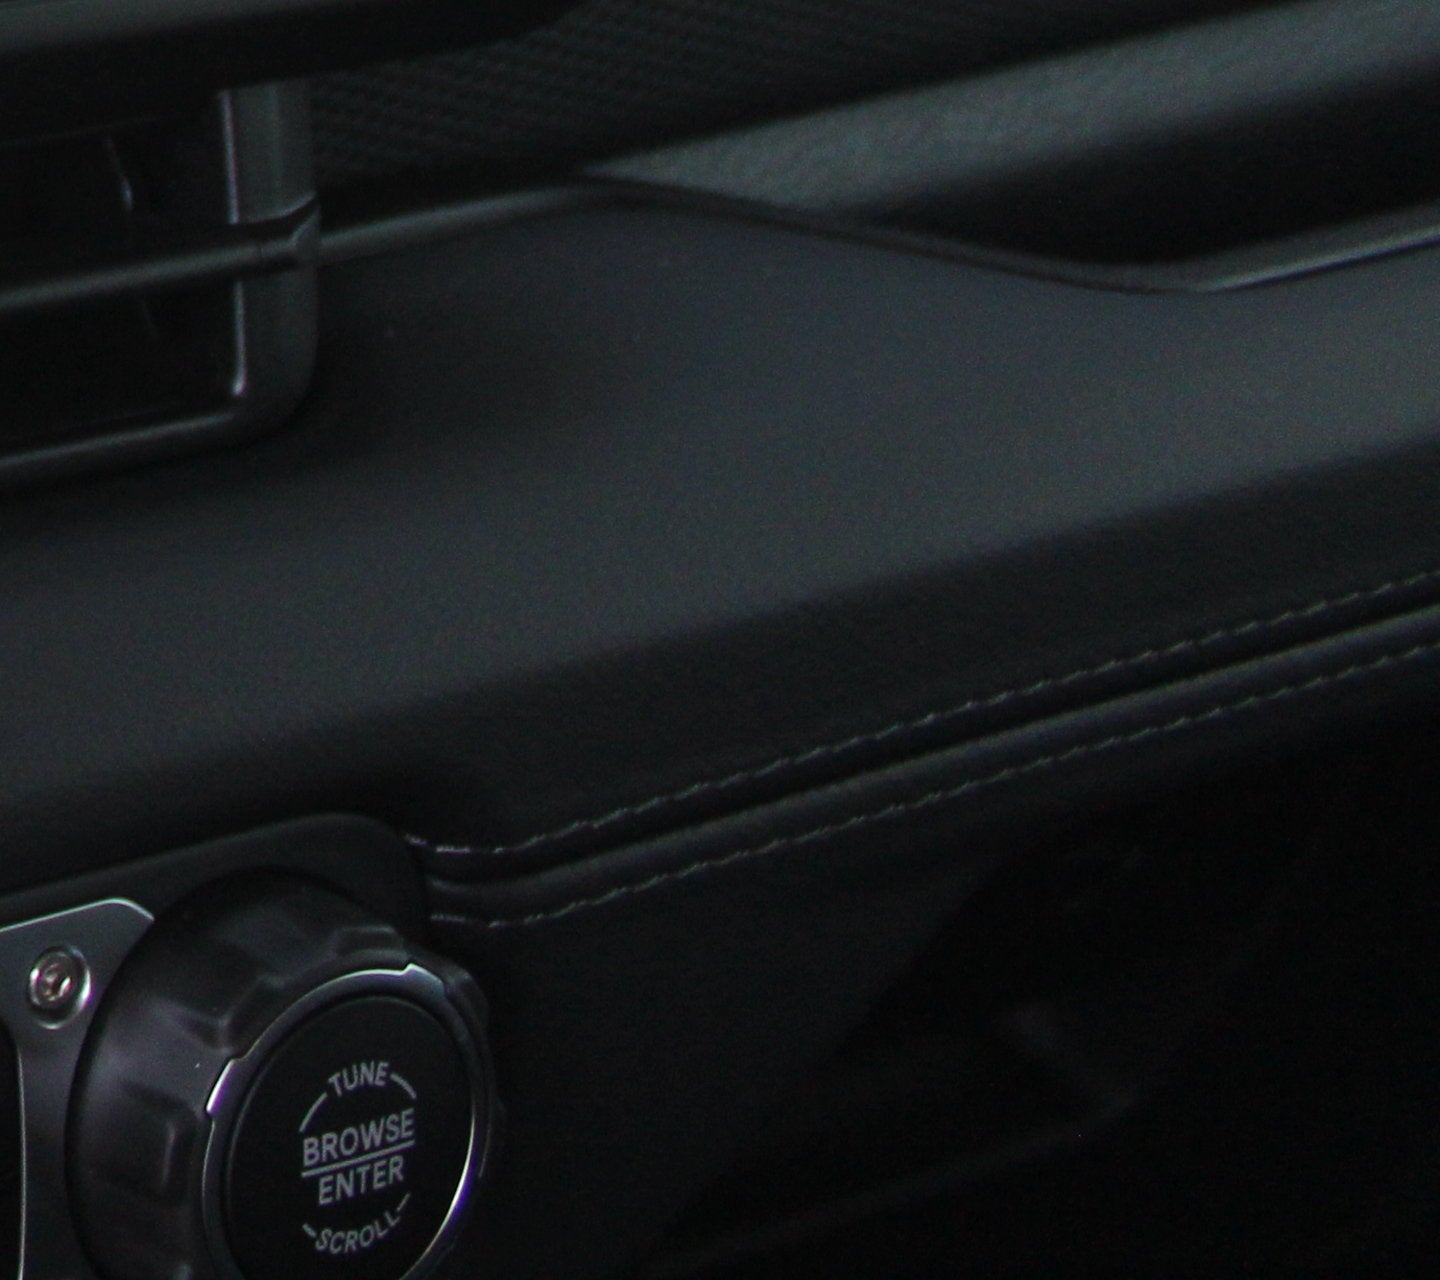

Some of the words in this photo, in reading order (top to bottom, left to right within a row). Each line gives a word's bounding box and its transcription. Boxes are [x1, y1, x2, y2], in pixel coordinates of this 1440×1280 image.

[327, 1059, 390, 1098] TUNE
[302, 1107, 416, 1167] BROWSE
[317, 1154, 405, 1206] ENTER
[314, 1210, 402, 1255] SCROLL
